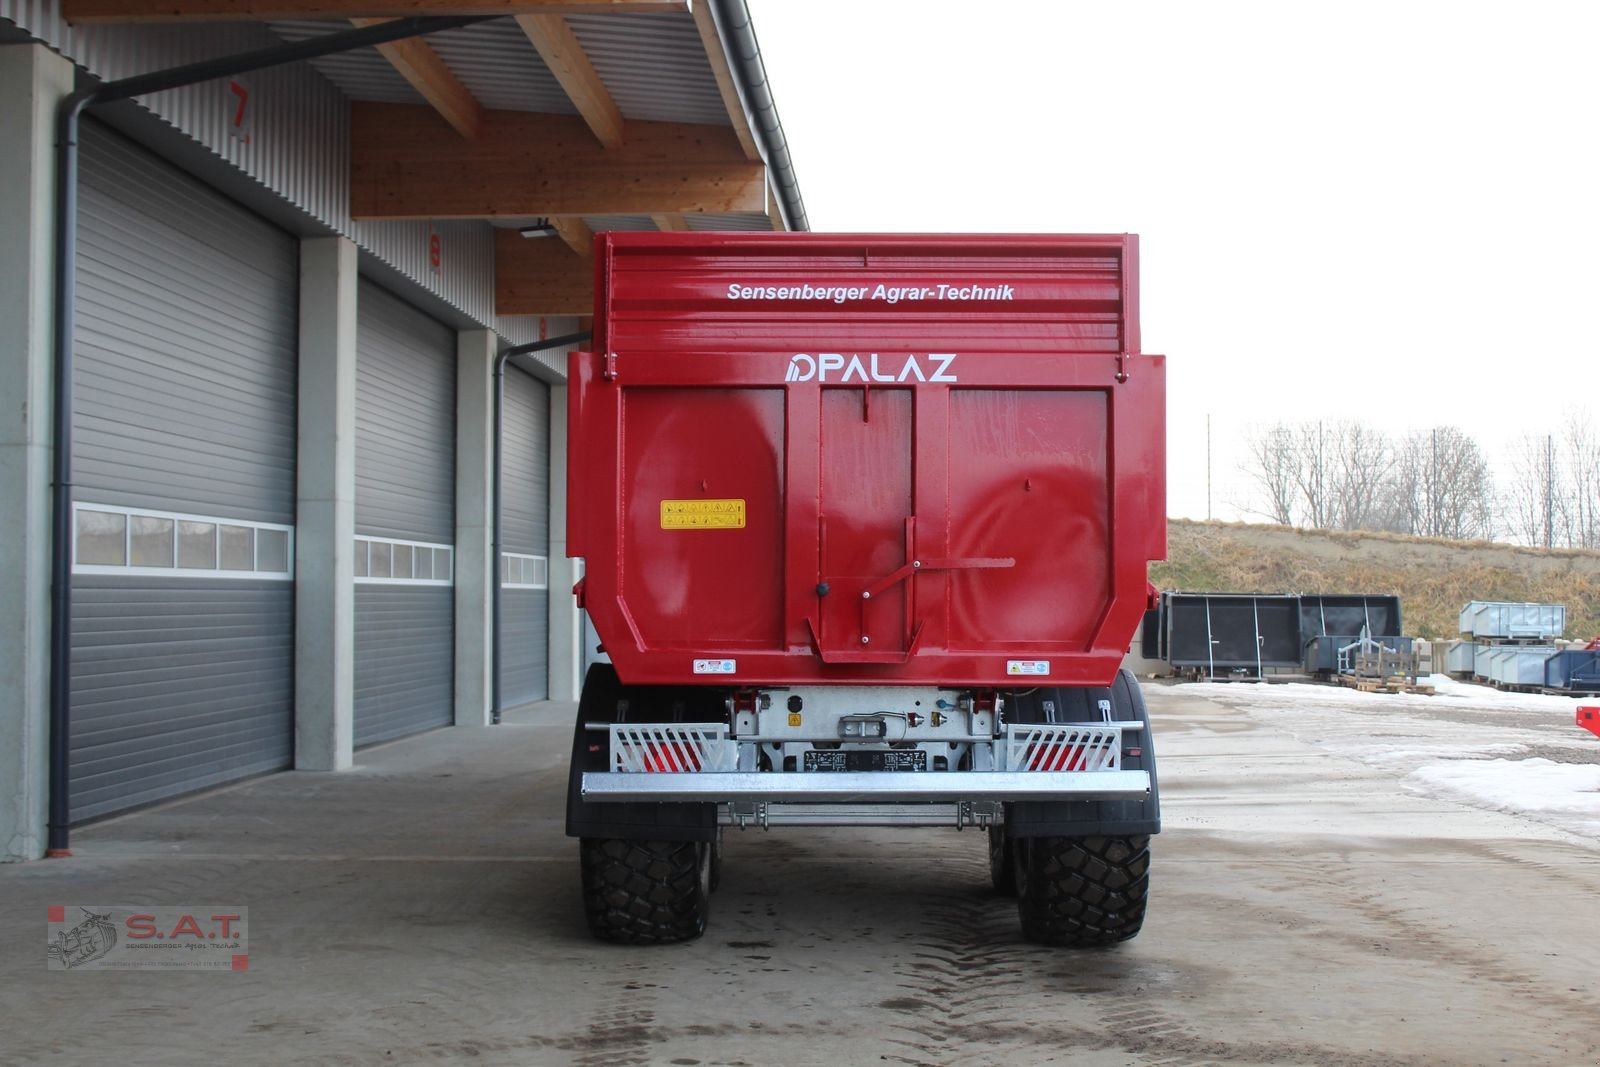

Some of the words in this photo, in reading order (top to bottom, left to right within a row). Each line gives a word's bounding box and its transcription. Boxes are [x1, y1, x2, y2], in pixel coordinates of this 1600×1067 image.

[229, 80, 249, 127] 7
[727, 284, 868, 303] Sensenberger
[871, 284, 1014, 303] Agrar-Technik
